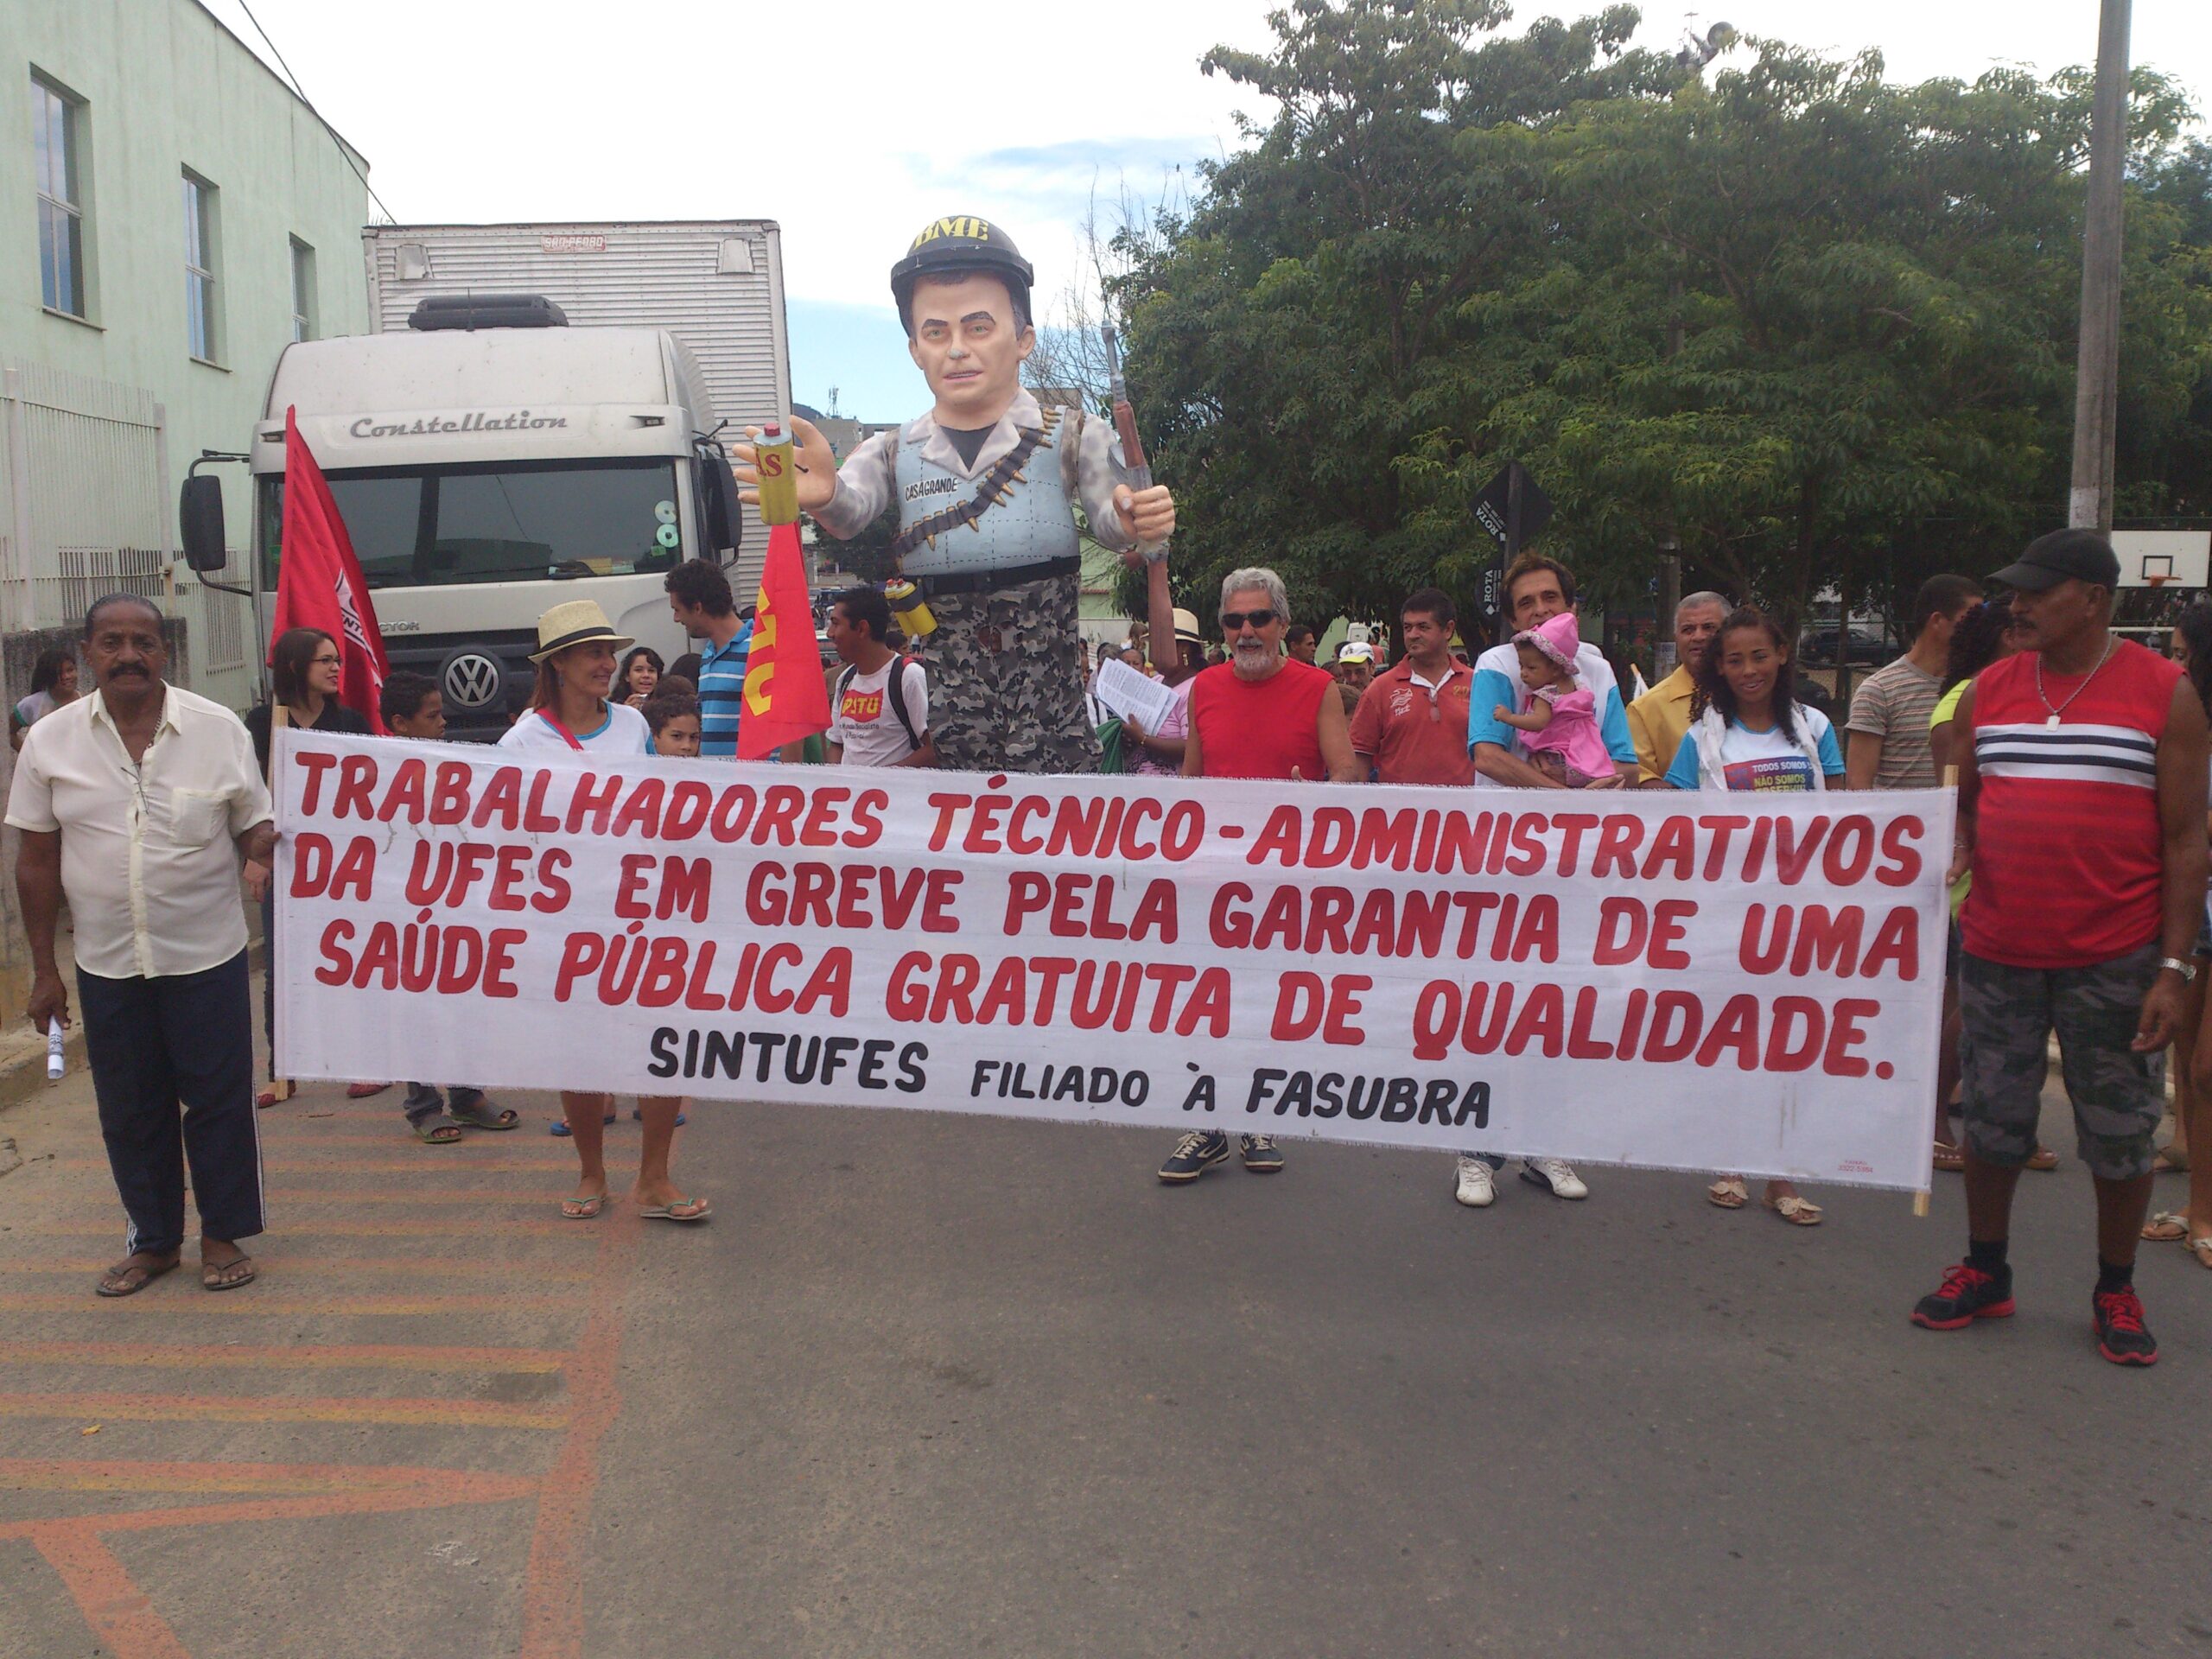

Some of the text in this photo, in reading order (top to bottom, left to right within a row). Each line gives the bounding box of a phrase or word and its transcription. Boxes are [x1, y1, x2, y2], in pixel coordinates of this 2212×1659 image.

[350, 410, 568, 438] Constellation
[905, 477, 958, 502] CASAGRANDE
[1476, 506, 1500, 537] ROTA
[1484, 569, 1494, 603] ROTA
[378, 620, 421, 632] CTOR
[1751, 764, 1780, 773] TODOS
[1780, 760, 1808, 771] SOMOS
[1753, 773, 1806, 787] NÃO SOMOS
[296, 752, 890, 849] TRABALHADORES
[290, 832, 1918, 981] DA UFES EM GREVE PELA GARANTIA DE UMA
[315, 908, 1894, 1079] SAÚDE PÚBLICA GRATUITA DE QUALIDADE.
[647, 1027, 1491, 1129] SINTUFES FILIADO À FASUBRA
